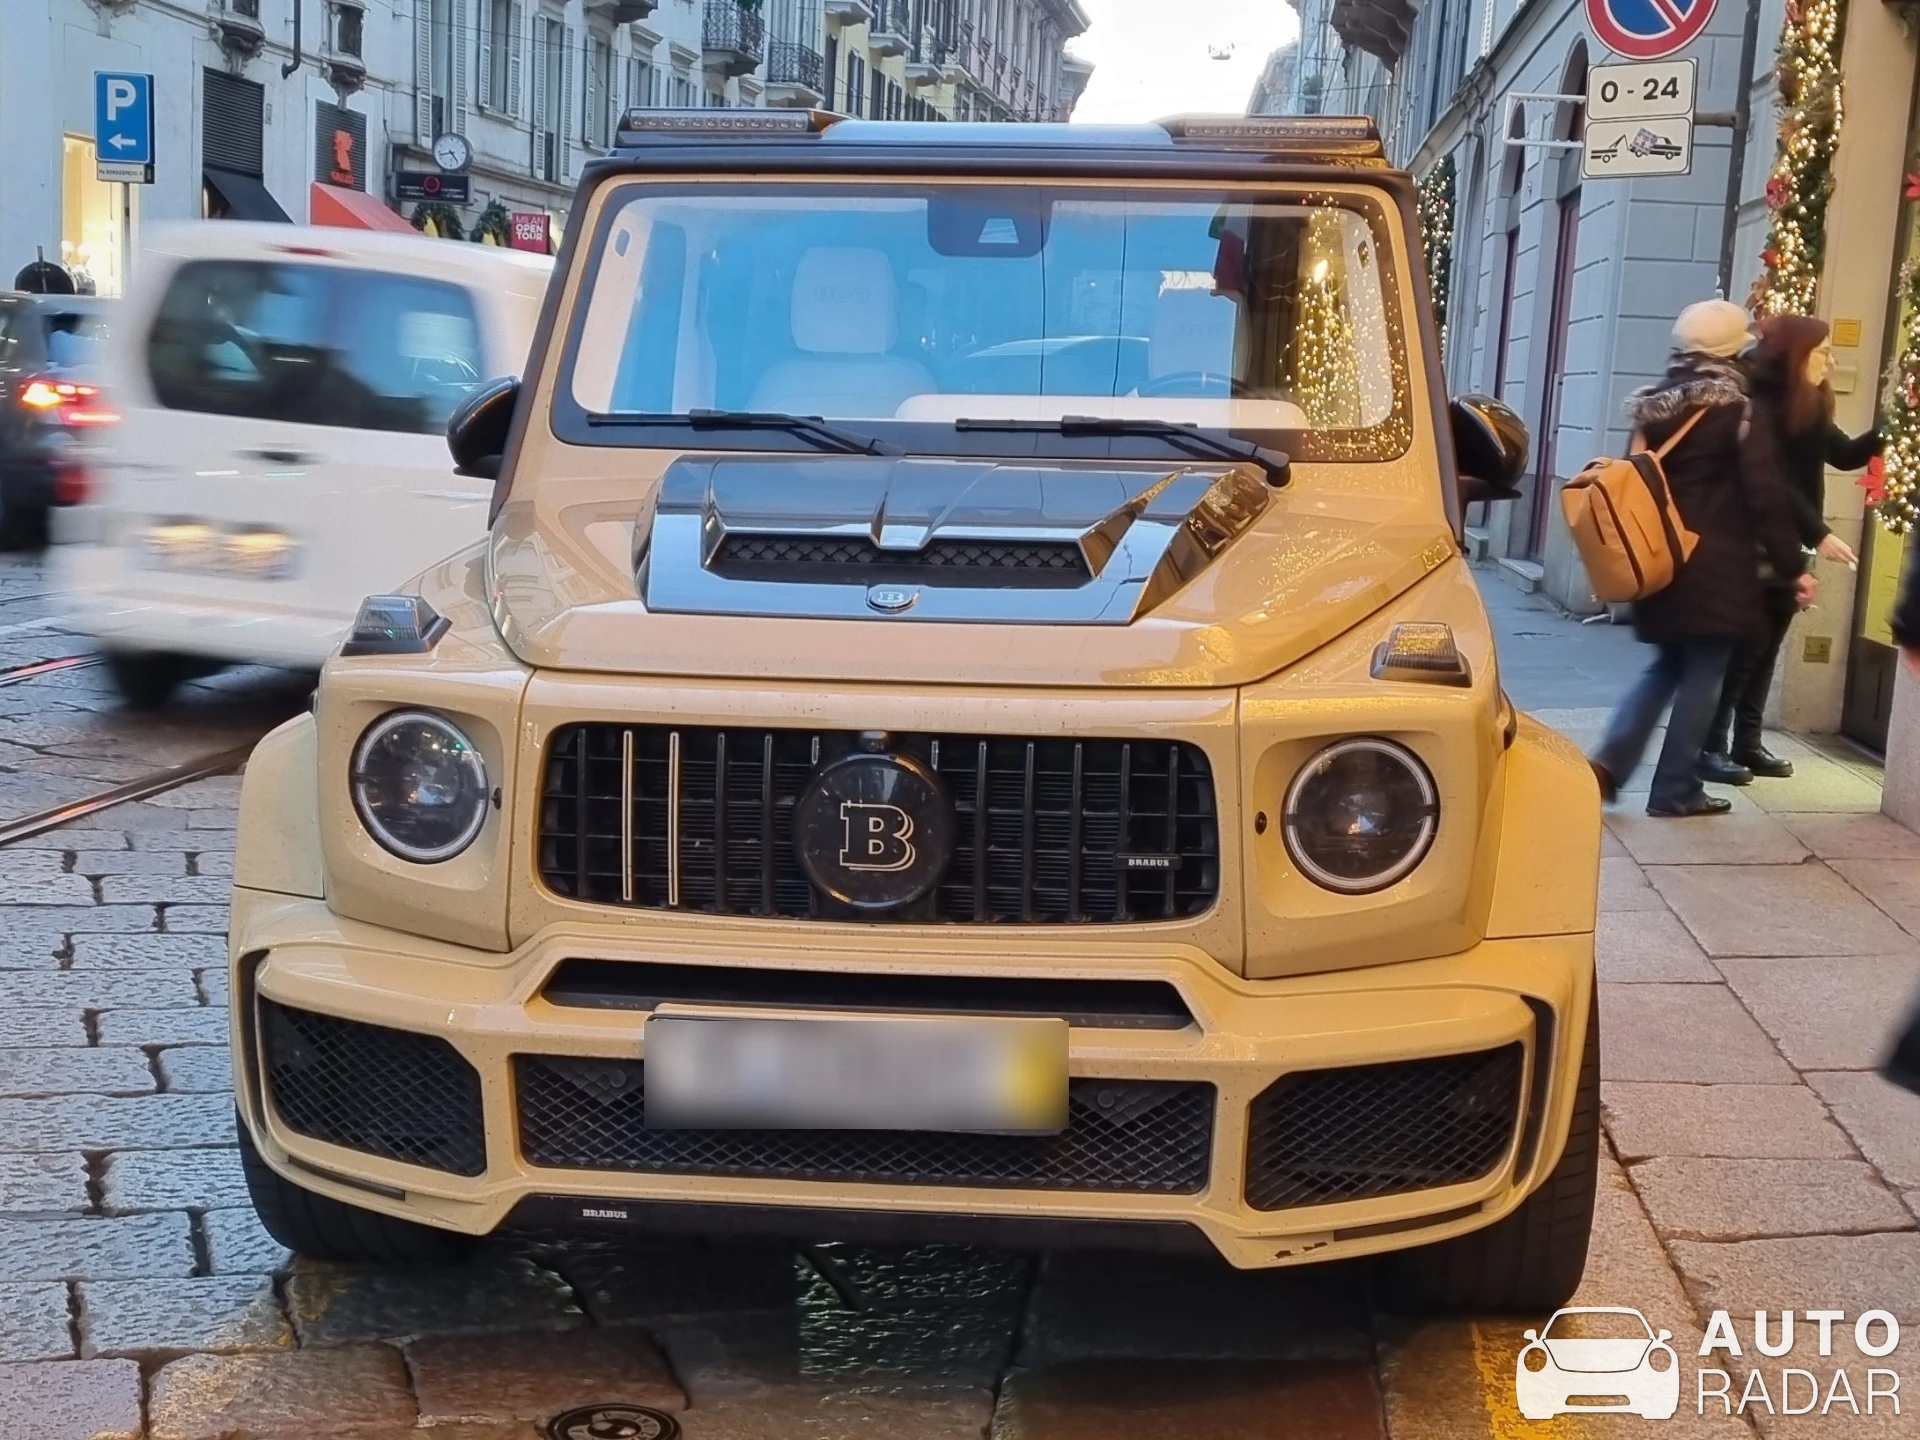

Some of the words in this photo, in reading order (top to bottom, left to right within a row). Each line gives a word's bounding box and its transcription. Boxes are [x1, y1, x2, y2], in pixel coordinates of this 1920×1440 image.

[1601, 81, 1619, 103] 0
[1643, 77, 1679, 100] 24
[107, 79, 136, 121] P
[515, 223, 544, 233] OPEN
[515, 231, 543, 241] TOUR
[839, 802, 916, 872] B
[1128, 858, 1170, 867] BRABUS
[582, 1209, 628, 1219] BRABUS
